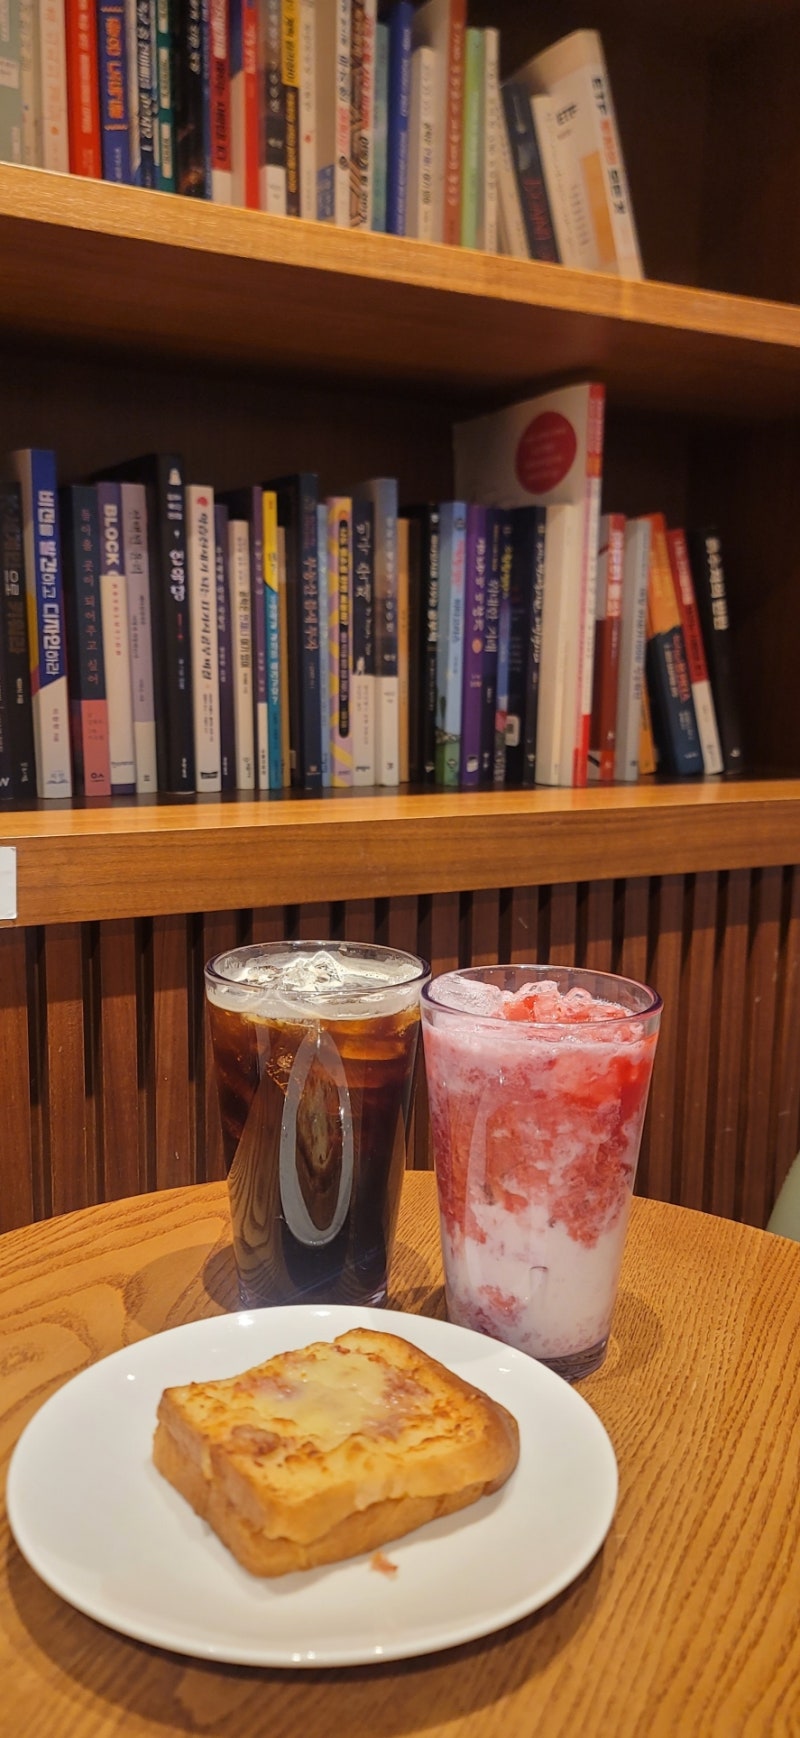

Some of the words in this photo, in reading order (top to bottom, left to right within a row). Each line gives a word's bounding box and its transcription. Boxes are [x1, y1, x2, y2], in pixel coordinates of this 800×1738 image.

[556, 102, 577, 126] ETF
[592, 77, 607, 116] ETF
[103, 503, 118, 566] BLOCK
[197, 512, 210, 573] 학습천재가
[39, 540, 58, 598] 발견하고
[200, 576, 210, 597] 되는
[303, 556, 317, 596] 부동산
[201, 600, 211, 633] 11가지
[486, 578, 499, 620] 위대한
[42, 603, 61, 675] 디자인하라
[202, 634, 211, 656] 공부
[87, 658, 99, 686] 싶어
[202, 657, 212, 681] 비결
